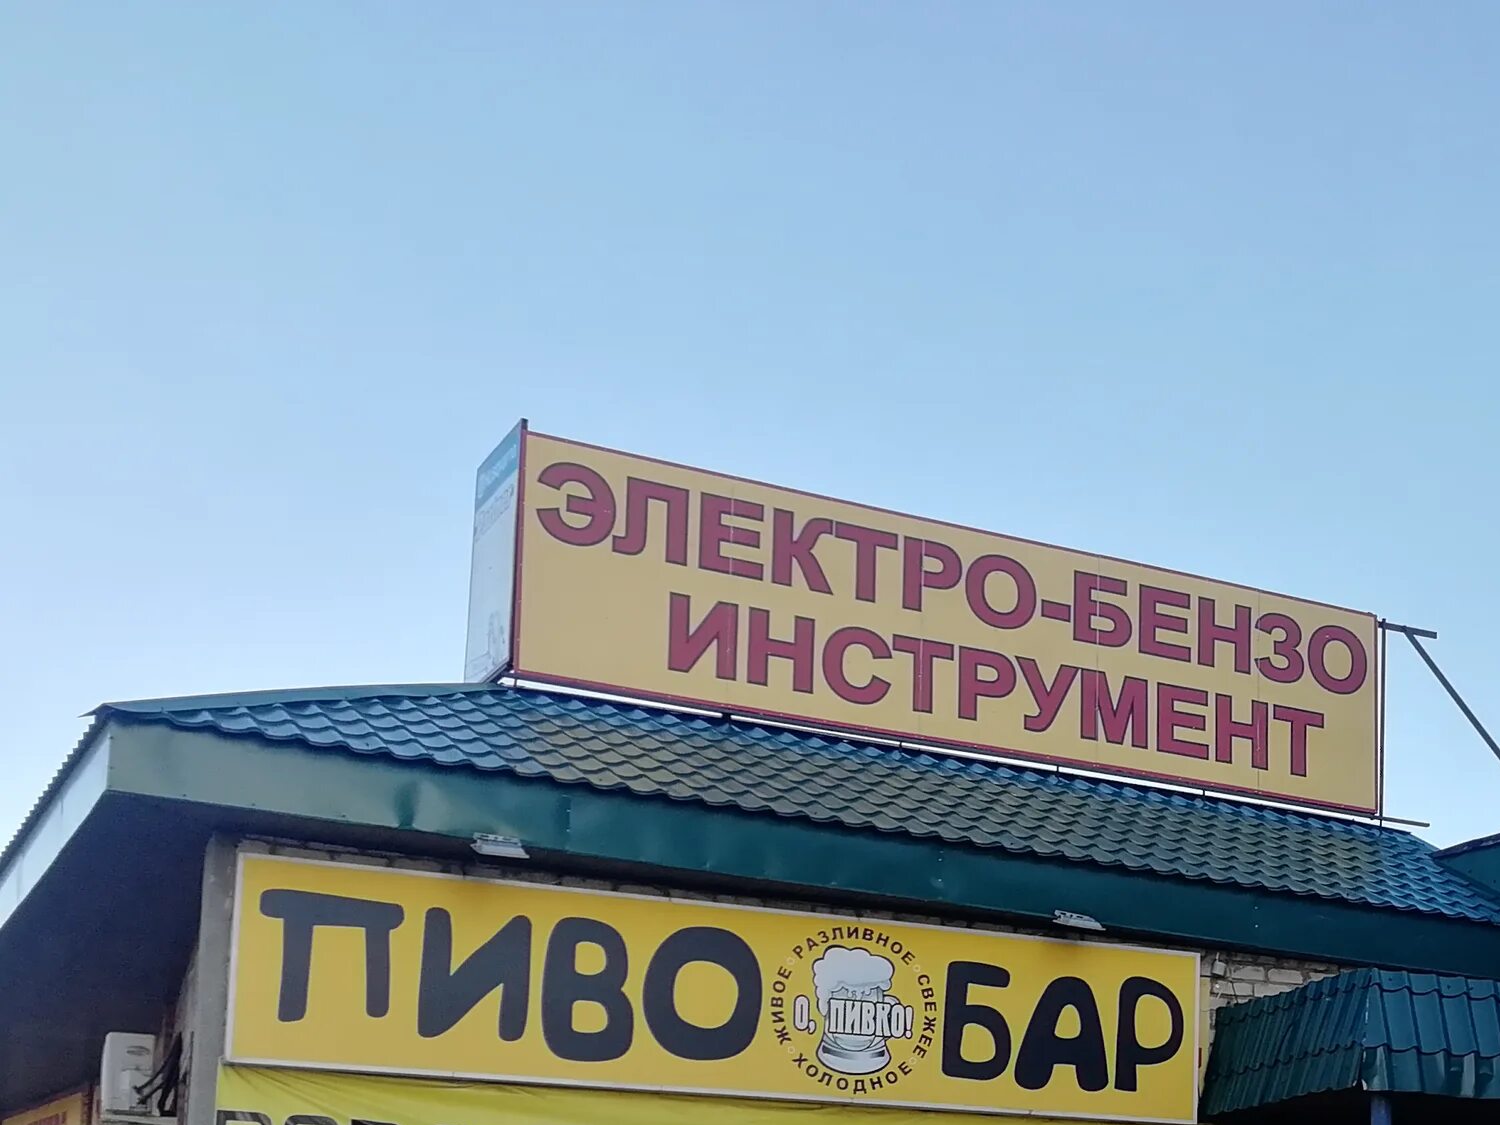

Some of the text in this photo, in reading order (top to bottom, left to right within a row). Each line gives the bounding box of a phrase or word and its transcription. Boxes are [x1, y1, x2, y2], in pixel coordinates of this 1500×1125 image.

[536, 462, 1368, 695] ЭЛЕКТРО-БЕНЗО
[667, 591, 1325, 778] ИНСТРУМЕНТ
[792, 926, 916, 966] РАЗЛИВНОЕ
[259, 888, 1185, 1093] ПИВО БАР
[771, 966, 793, 1045] ЖИВОЕ
[828, 998, 914, 1039] ПИВКО!
[912, 974, 937, 1059] СВЕЖЕЕ
[792, 1053, 912, 1094] ХОЛОДНОЕ
